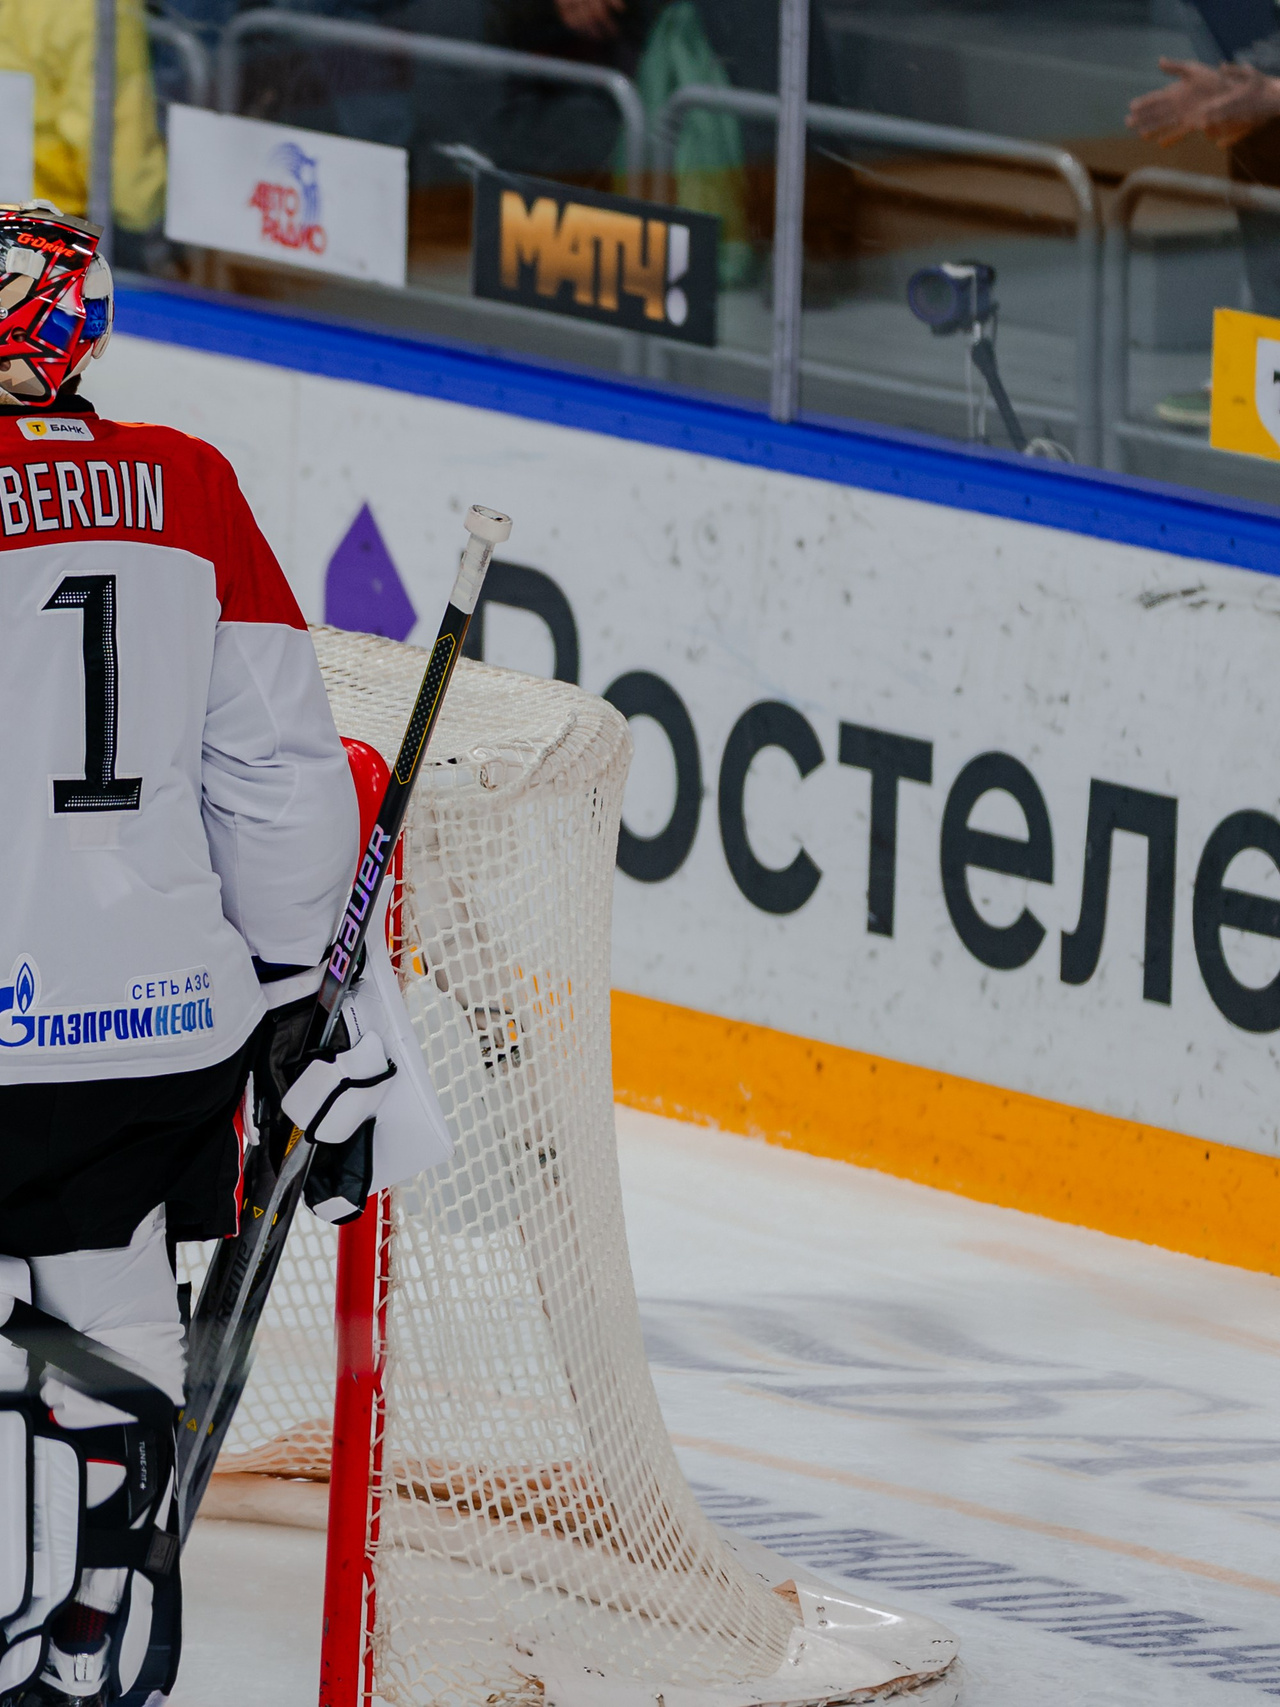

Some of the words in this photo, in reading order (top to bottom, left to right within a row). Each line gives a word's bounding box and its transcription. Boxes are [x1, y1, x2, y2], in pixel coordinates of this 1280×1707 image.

[500, 190, 690, 327] МАТЧ!
[50, 424, 85, 434] БАНК
[39, 572, 143, 815] 1
[132, 979, 180, 1000] СЕТЬ
[184, 972, 210, 994] АЗС
[37, 997, 214, 1047] ГАЗПРОМНЕФТЬ
